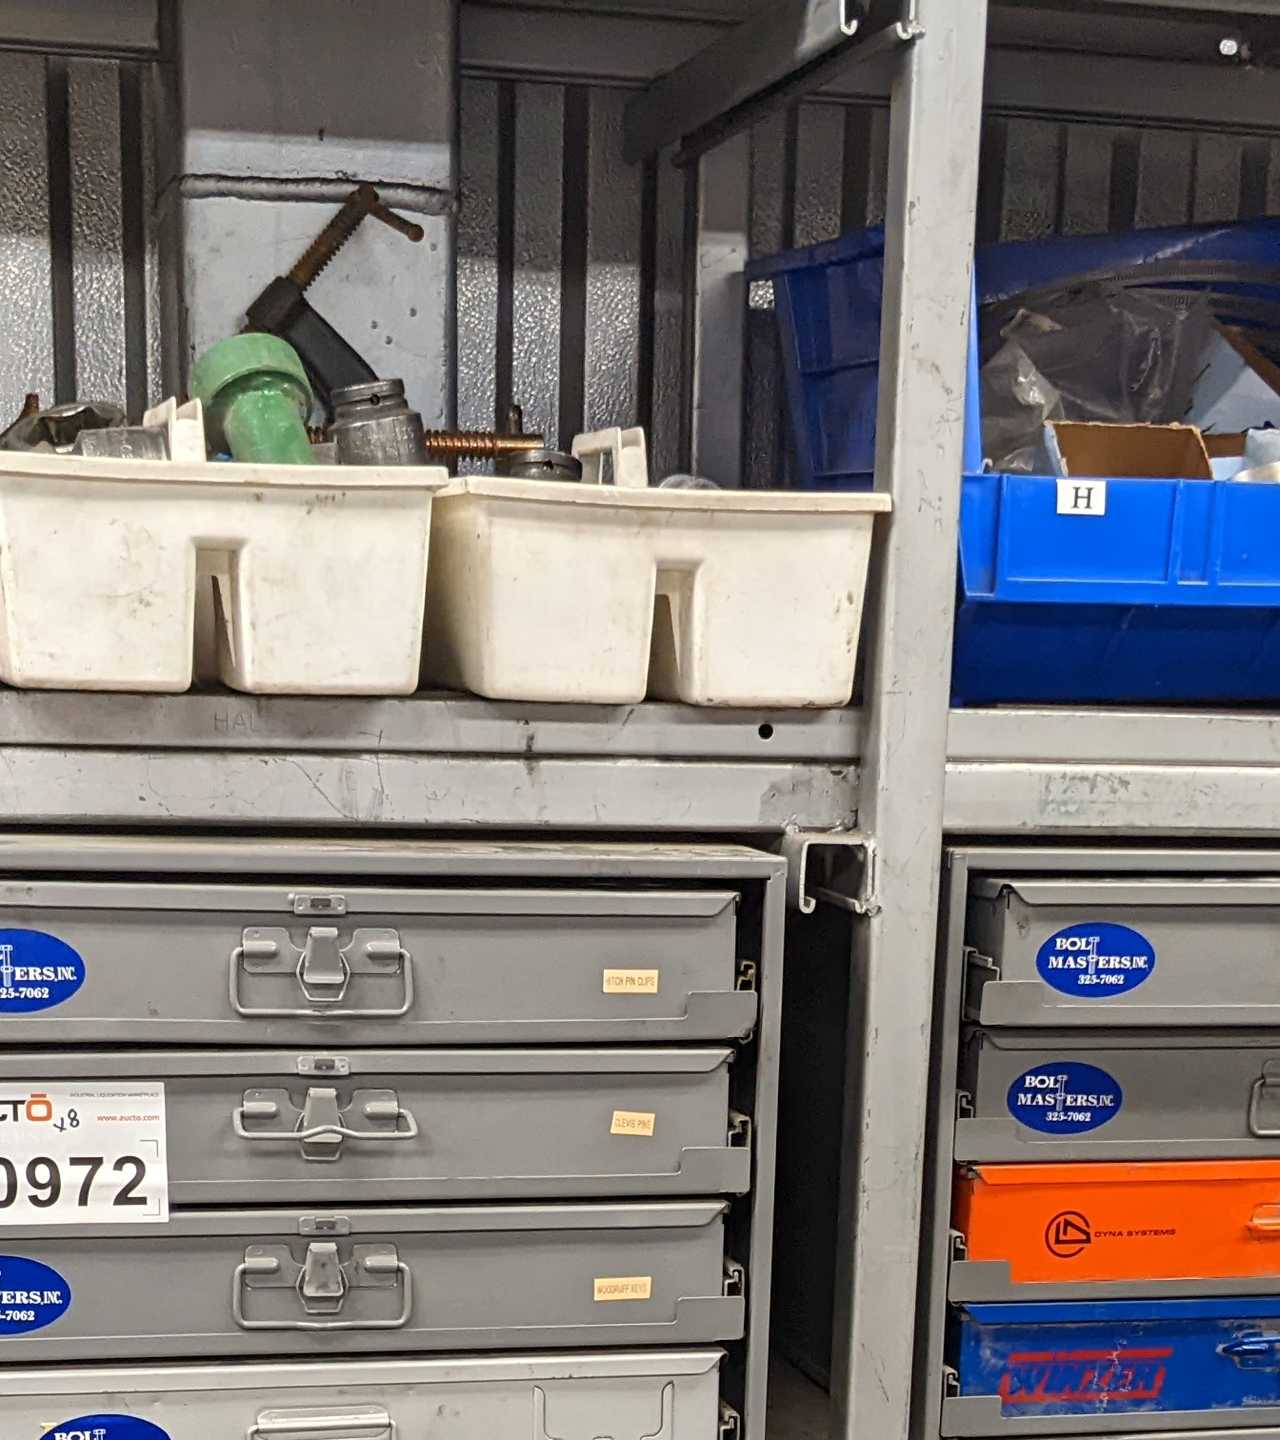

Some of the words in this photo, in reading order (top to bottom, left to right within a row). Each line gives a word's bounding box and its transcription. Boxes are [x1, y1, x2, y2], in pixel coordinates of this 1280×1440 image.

[1073, 487, 1094, 509] H
[1077, 974, 1124, 984] 325-7062
[1045, 1111, 1091, 1122] 325-7062
[1126, 1229, 1177, 1237] SYSTEMS
